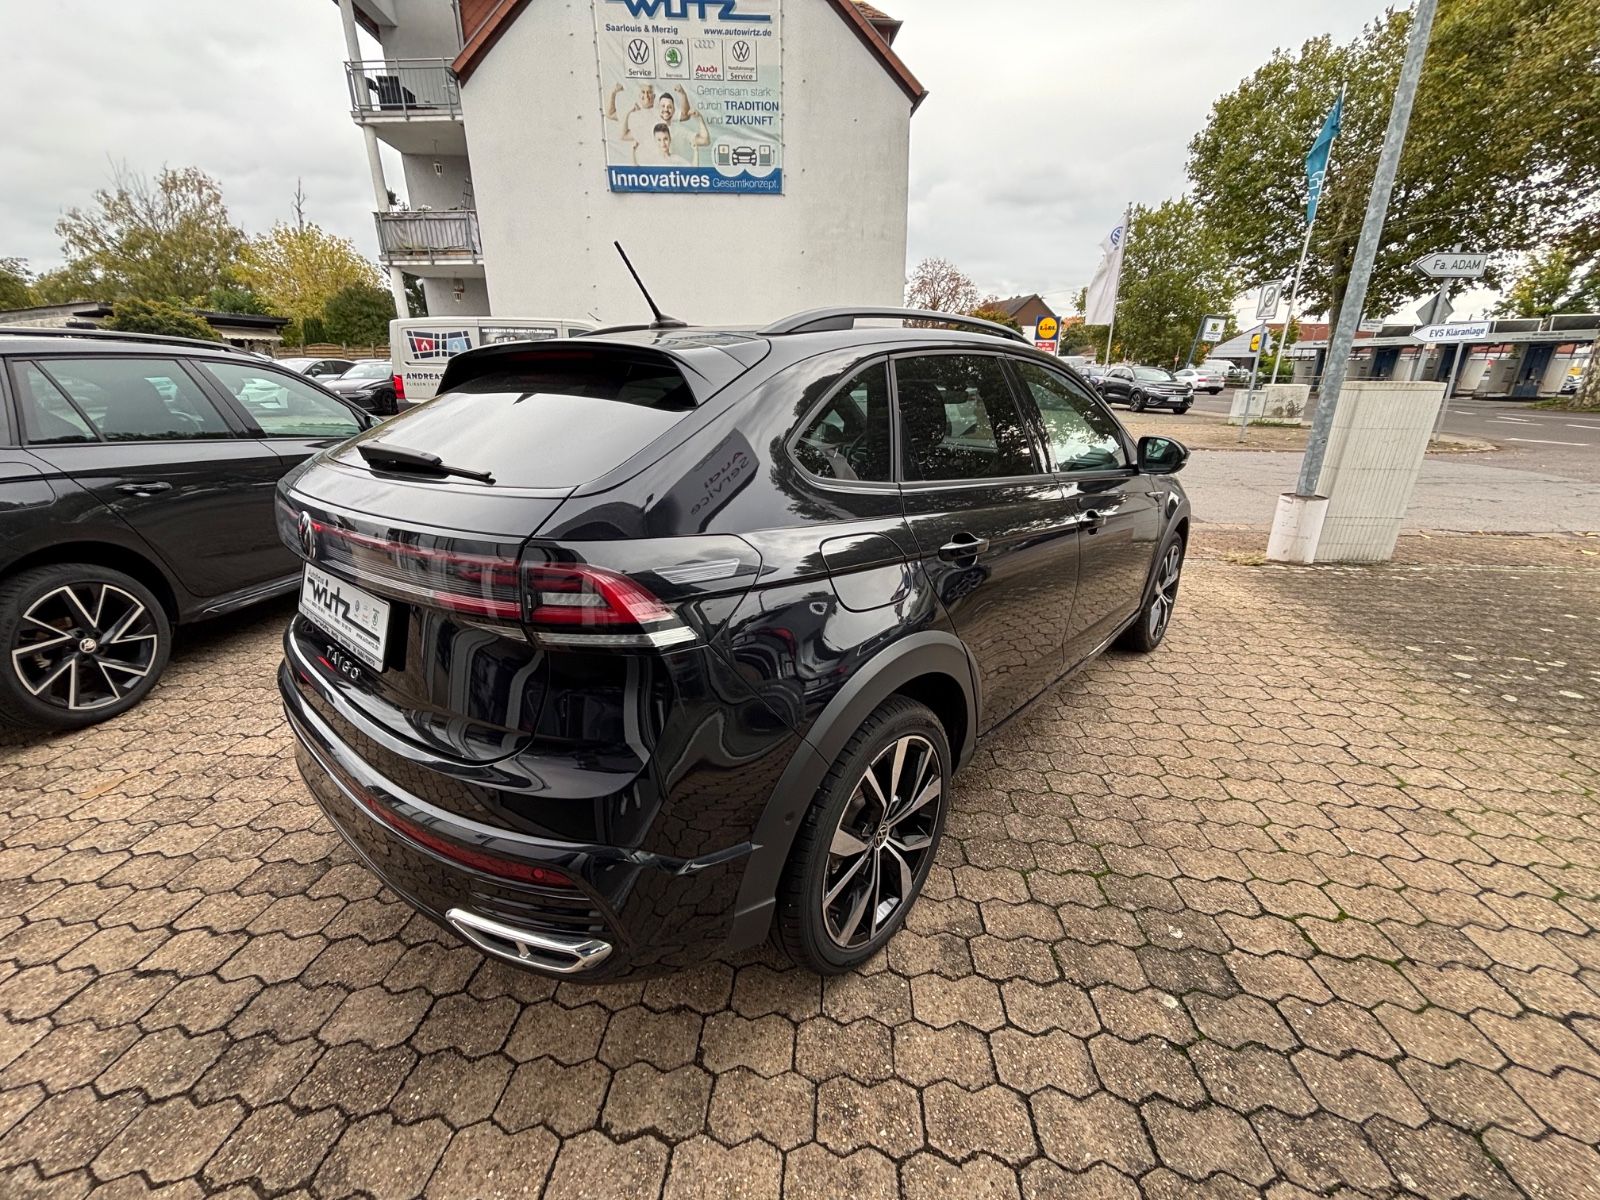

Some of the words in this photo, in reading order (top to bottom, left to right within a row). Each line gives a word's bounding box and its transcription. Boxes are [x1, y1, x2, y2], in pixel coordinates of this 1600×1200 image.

[606, 24, 642, 32] Saarlouis
[652, 25, 678, 35] Merzig
[704, 28, 772, 37] www.autowirtz.de
[696, 65, 718, 73] Audi
[697, 85, 748, 96] Gemeinsam
[751, 87, 771, 96] stark
[698, 102, 721, 111] durch
[724, 101, 779, 111] TRADITION
[707, 116, 723, 125] und
[726, 115, 774, 125] ZUKUNFT
[611, 170, 710, 188] Innovatives
[713, 178, 779, 190] Gesamtkonzept.
[1433, 260, 1447, 270] Fa.
[1451, 260, 1482, 270] ADAM
[1429, 329, 1444, 338] EVS
